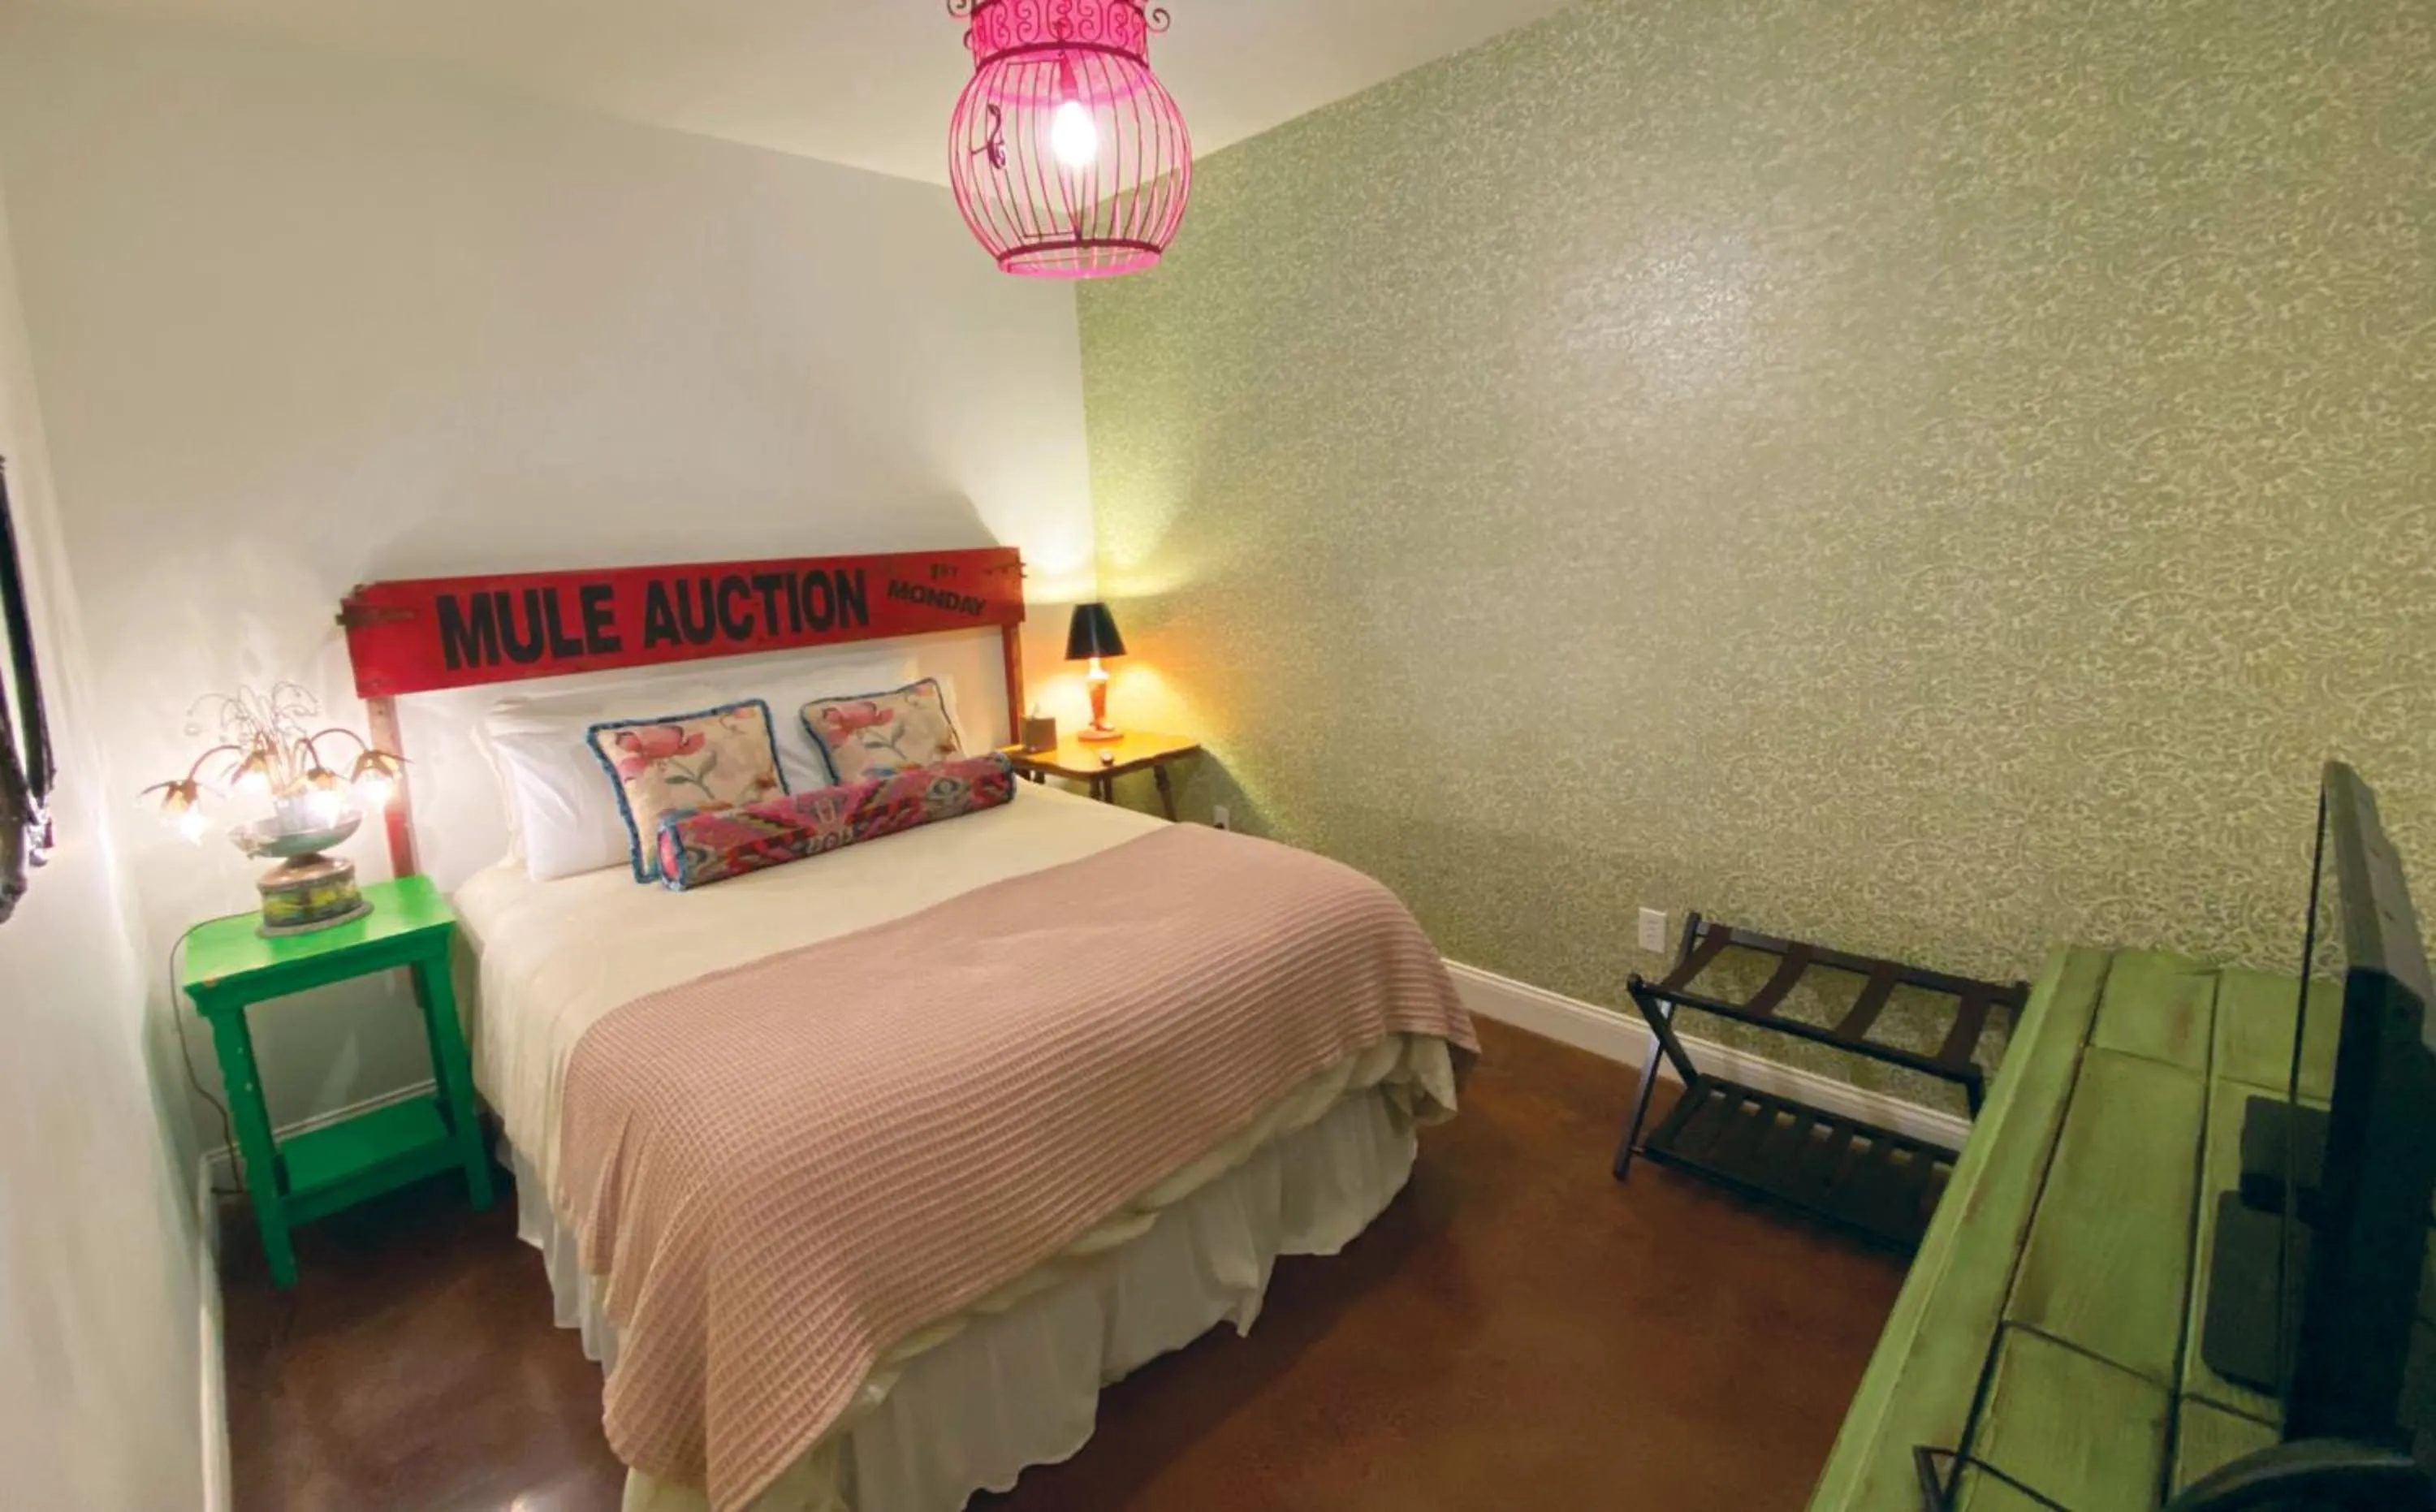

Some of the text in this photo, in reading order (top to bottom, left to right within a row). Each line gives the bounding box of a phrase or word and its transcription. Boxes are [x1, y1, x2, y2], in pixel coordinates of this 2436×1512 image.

[435, 568, 869, 670] MULE AUCTION
[887, 579, 986, 616] MONDAY
